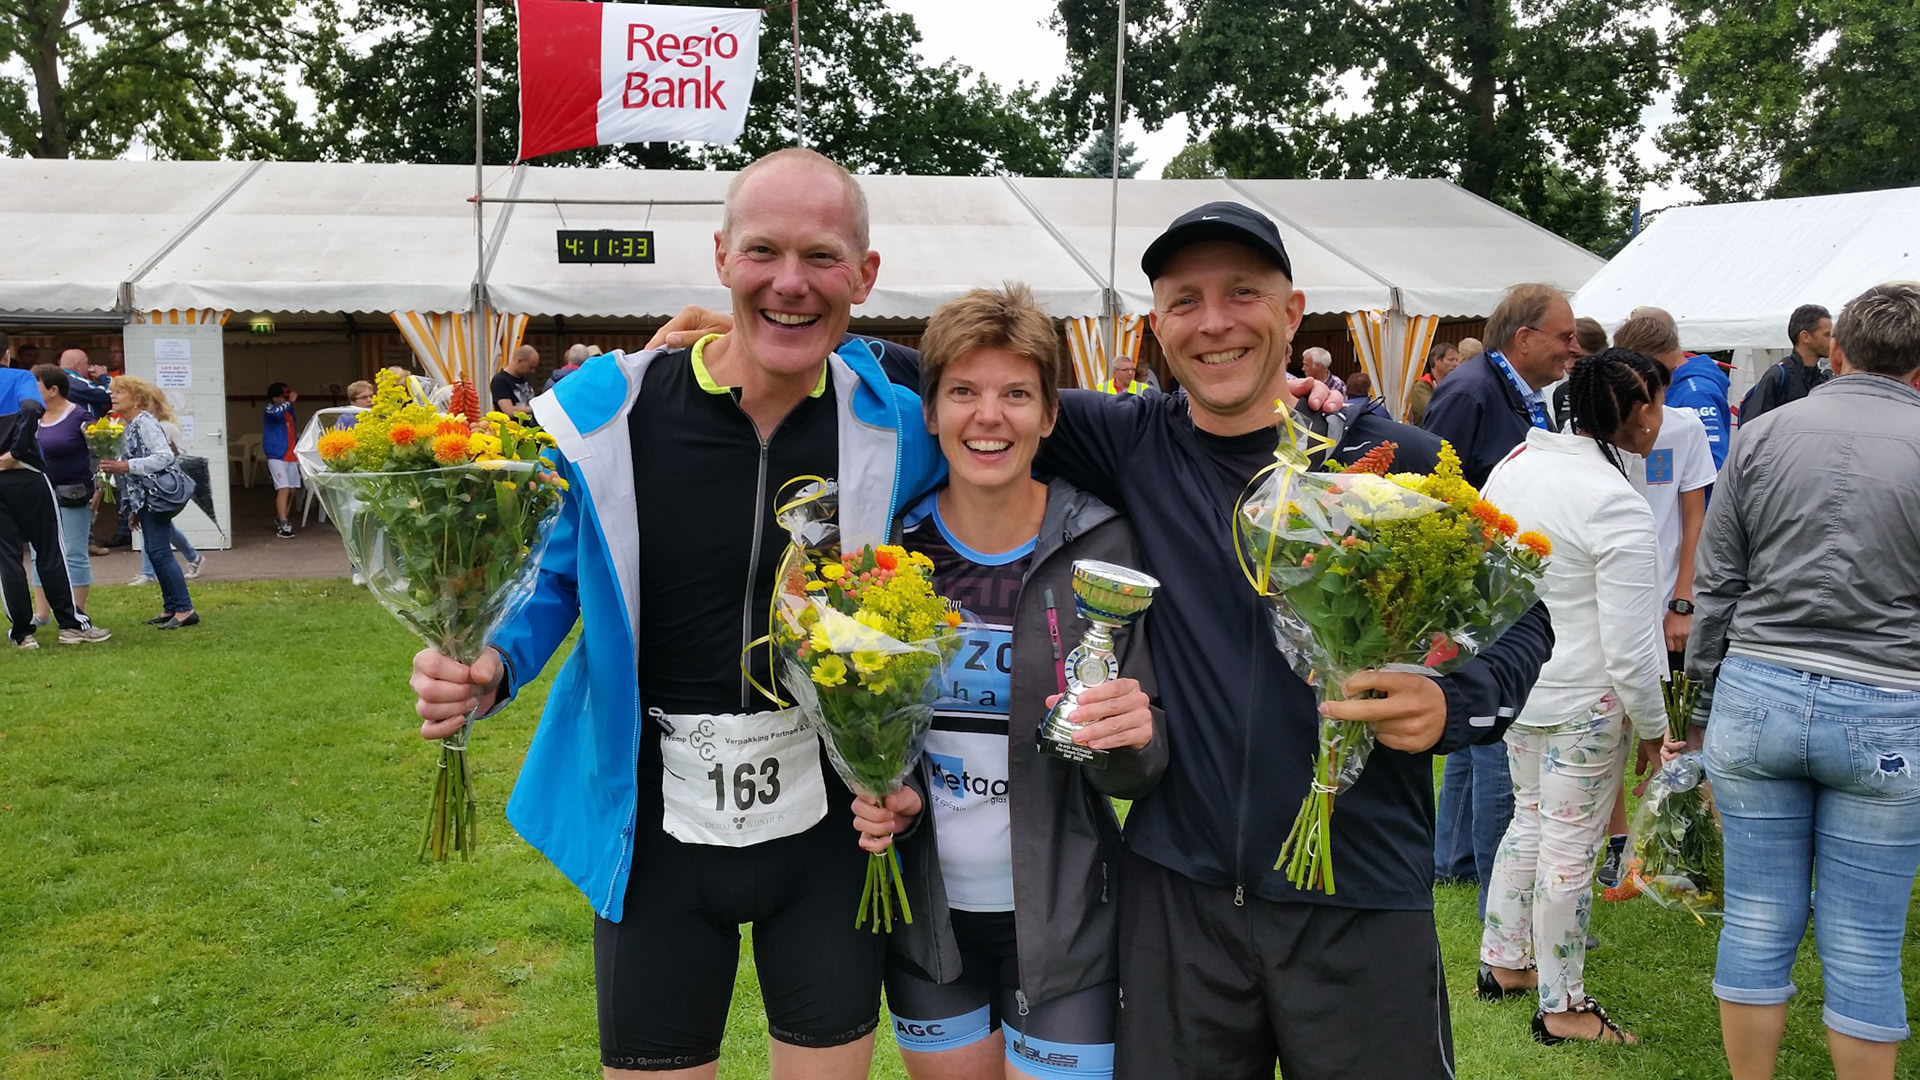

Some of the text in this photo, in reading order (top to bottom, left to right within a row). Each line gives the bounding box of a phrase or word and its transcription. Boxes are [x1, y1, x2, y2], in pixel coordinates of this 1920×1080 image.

[627, 23, 738, 67] Regio
[622, 65, 727, 110] Bank
[565, 238, 648, 258] 4:11:33
[725, 733, 769, 745] Verpakking
[708, 757, 780, 811] 163
[896, 1020, 946, 1037] AGC
